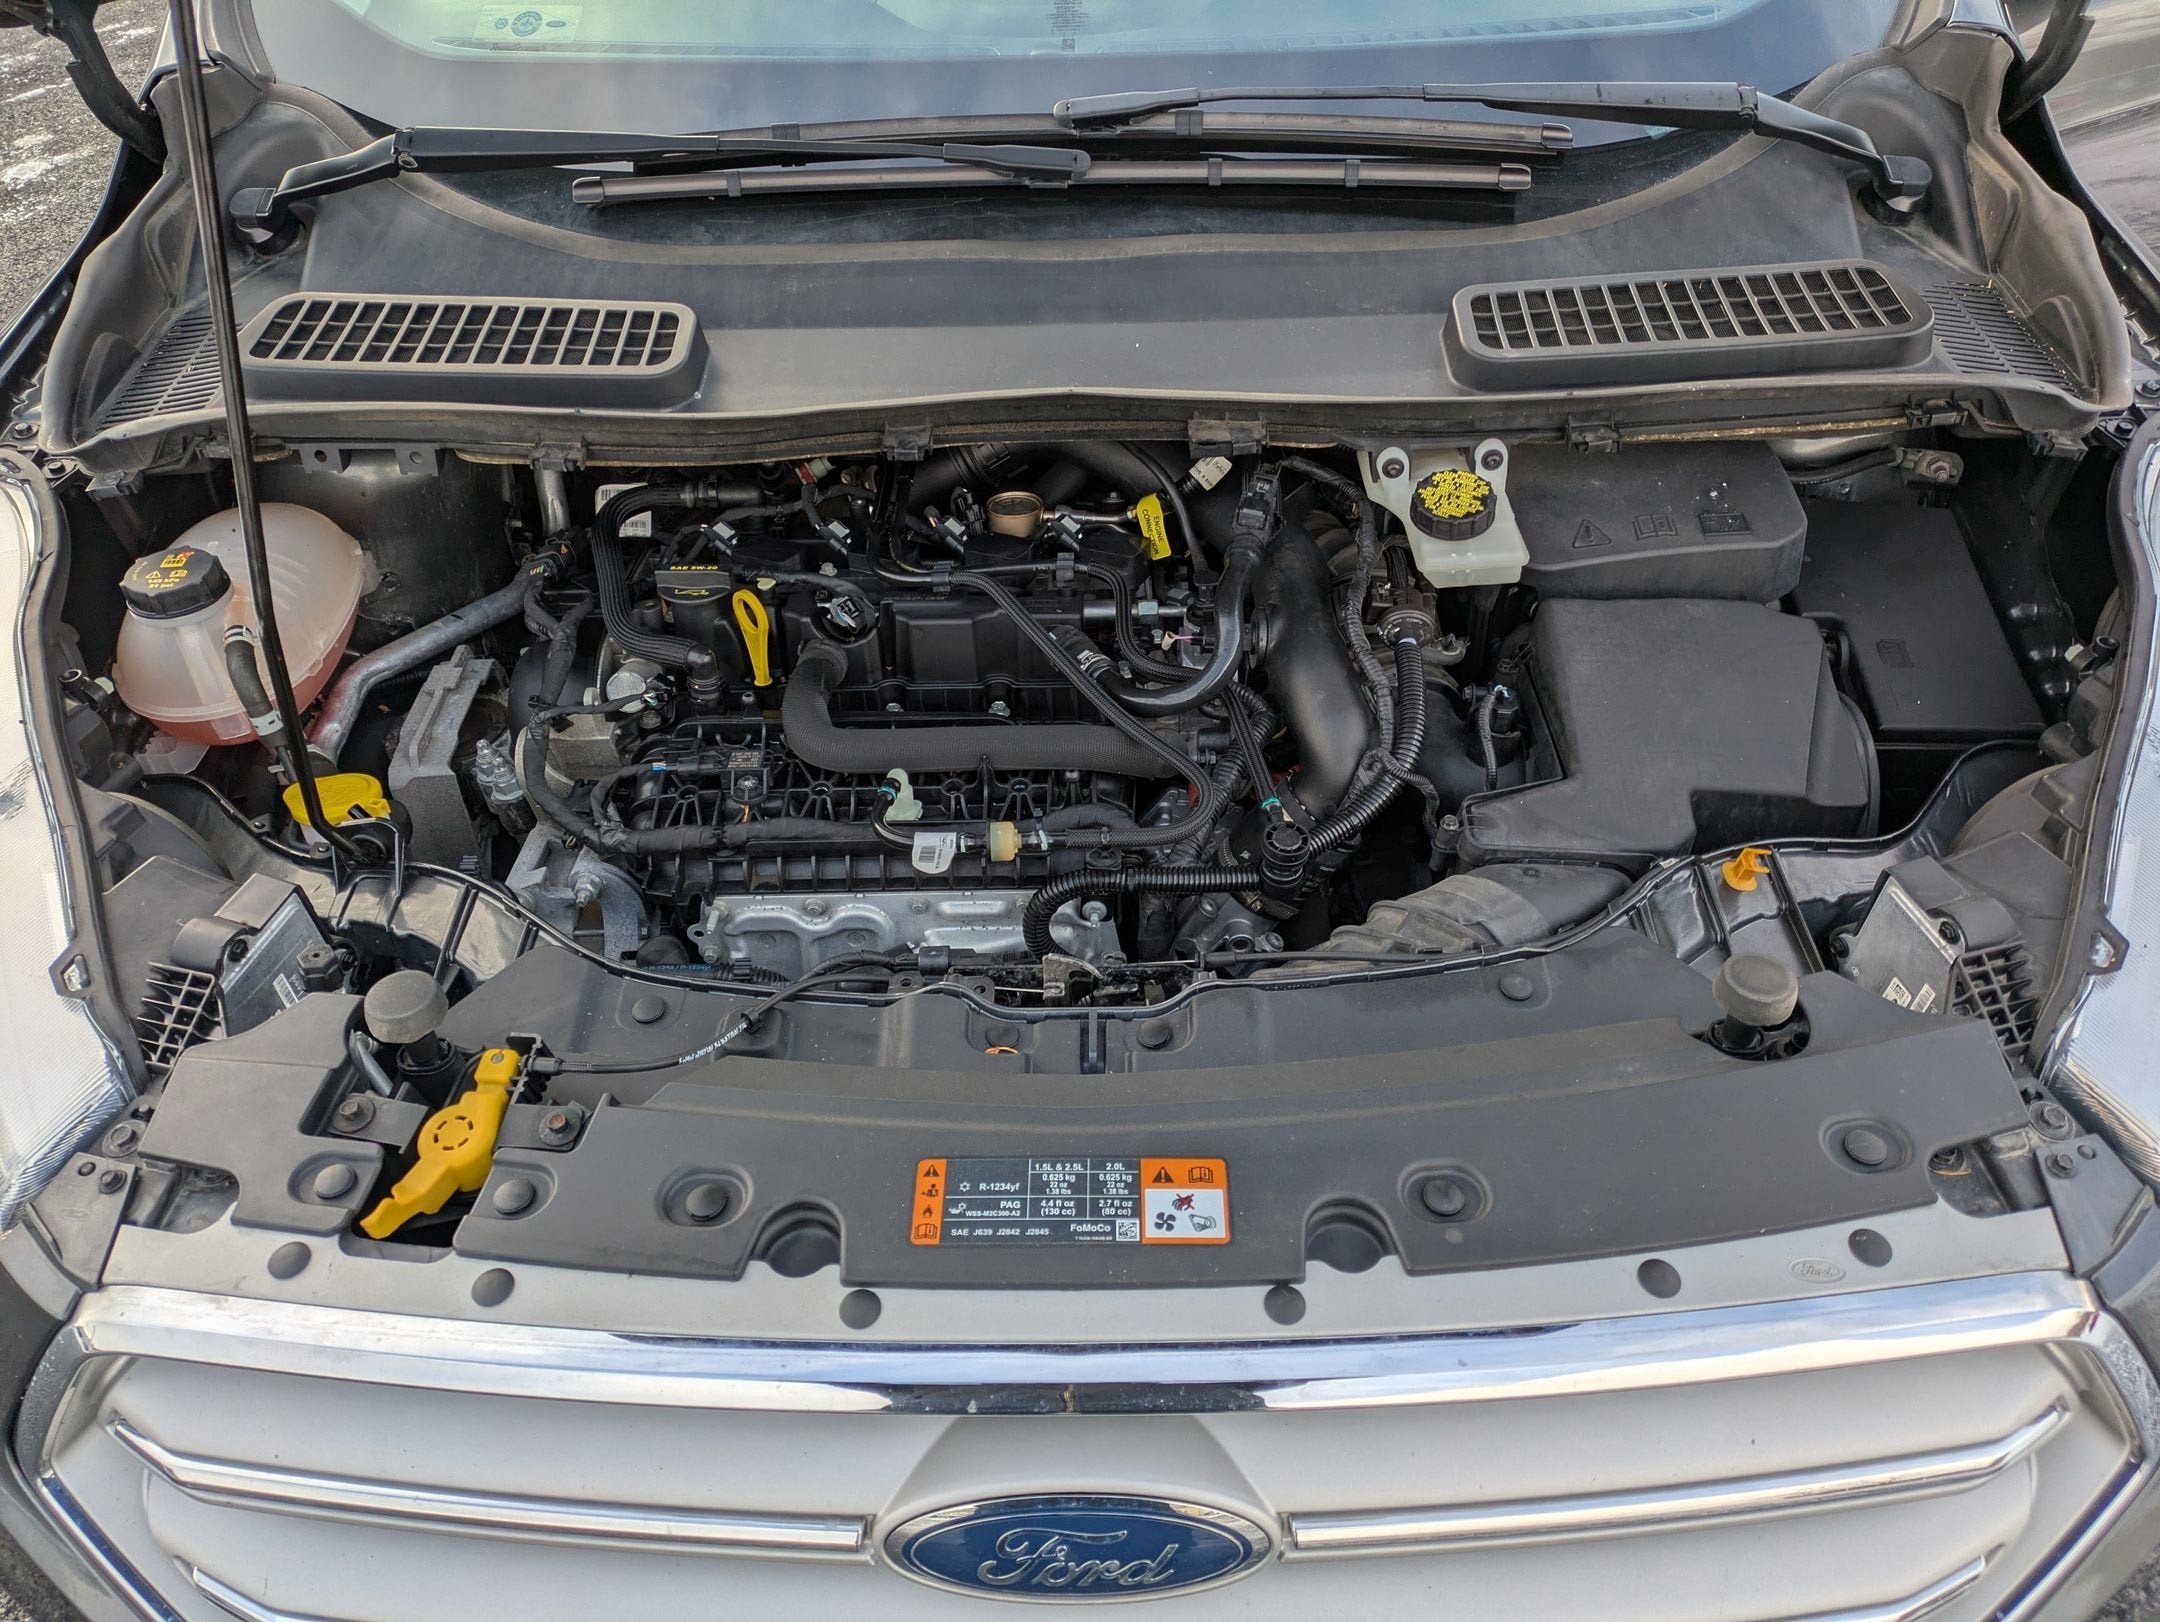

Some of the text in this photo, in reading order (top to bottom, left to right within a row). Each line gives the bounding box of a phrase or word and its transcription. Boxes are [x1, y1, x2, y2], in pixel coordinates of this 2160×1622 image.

[1142, 509, 1160, 555] CONNECTION
[1153, 515, 1165, 544] ENGINE
[1034, 1163, 1084, 1171] 1.5L & 2.5L
[1105, 1162, 1126, 1171] 2.0L
[1042, 1173, 1076, 1183] 0.625 kg
[1098, 1173, 1132, 1183] 0.625 kg
[979, 1183, 1020, 1192] R-1234yf
[1000, 1201, 1021, 1209] PAG
[1040, 1199, 1075, 1208] 4.4 fl oz
[1098, 1199, 1133, 1208] 2.7 fl oz
[1040, 1208, 1076, 1217] (130 cc)
[1101, 1208, 1132, 1217] (80 cc)
[972, 1228, 993, 1236] J639
[996, 1228, 1020, 1236] J2842
[1025, 1228, 1049, 1236] J2845
[1070, 1224, 1111, 1232] FoMoCo
[976, 1527, 1179, 1587] Ford
